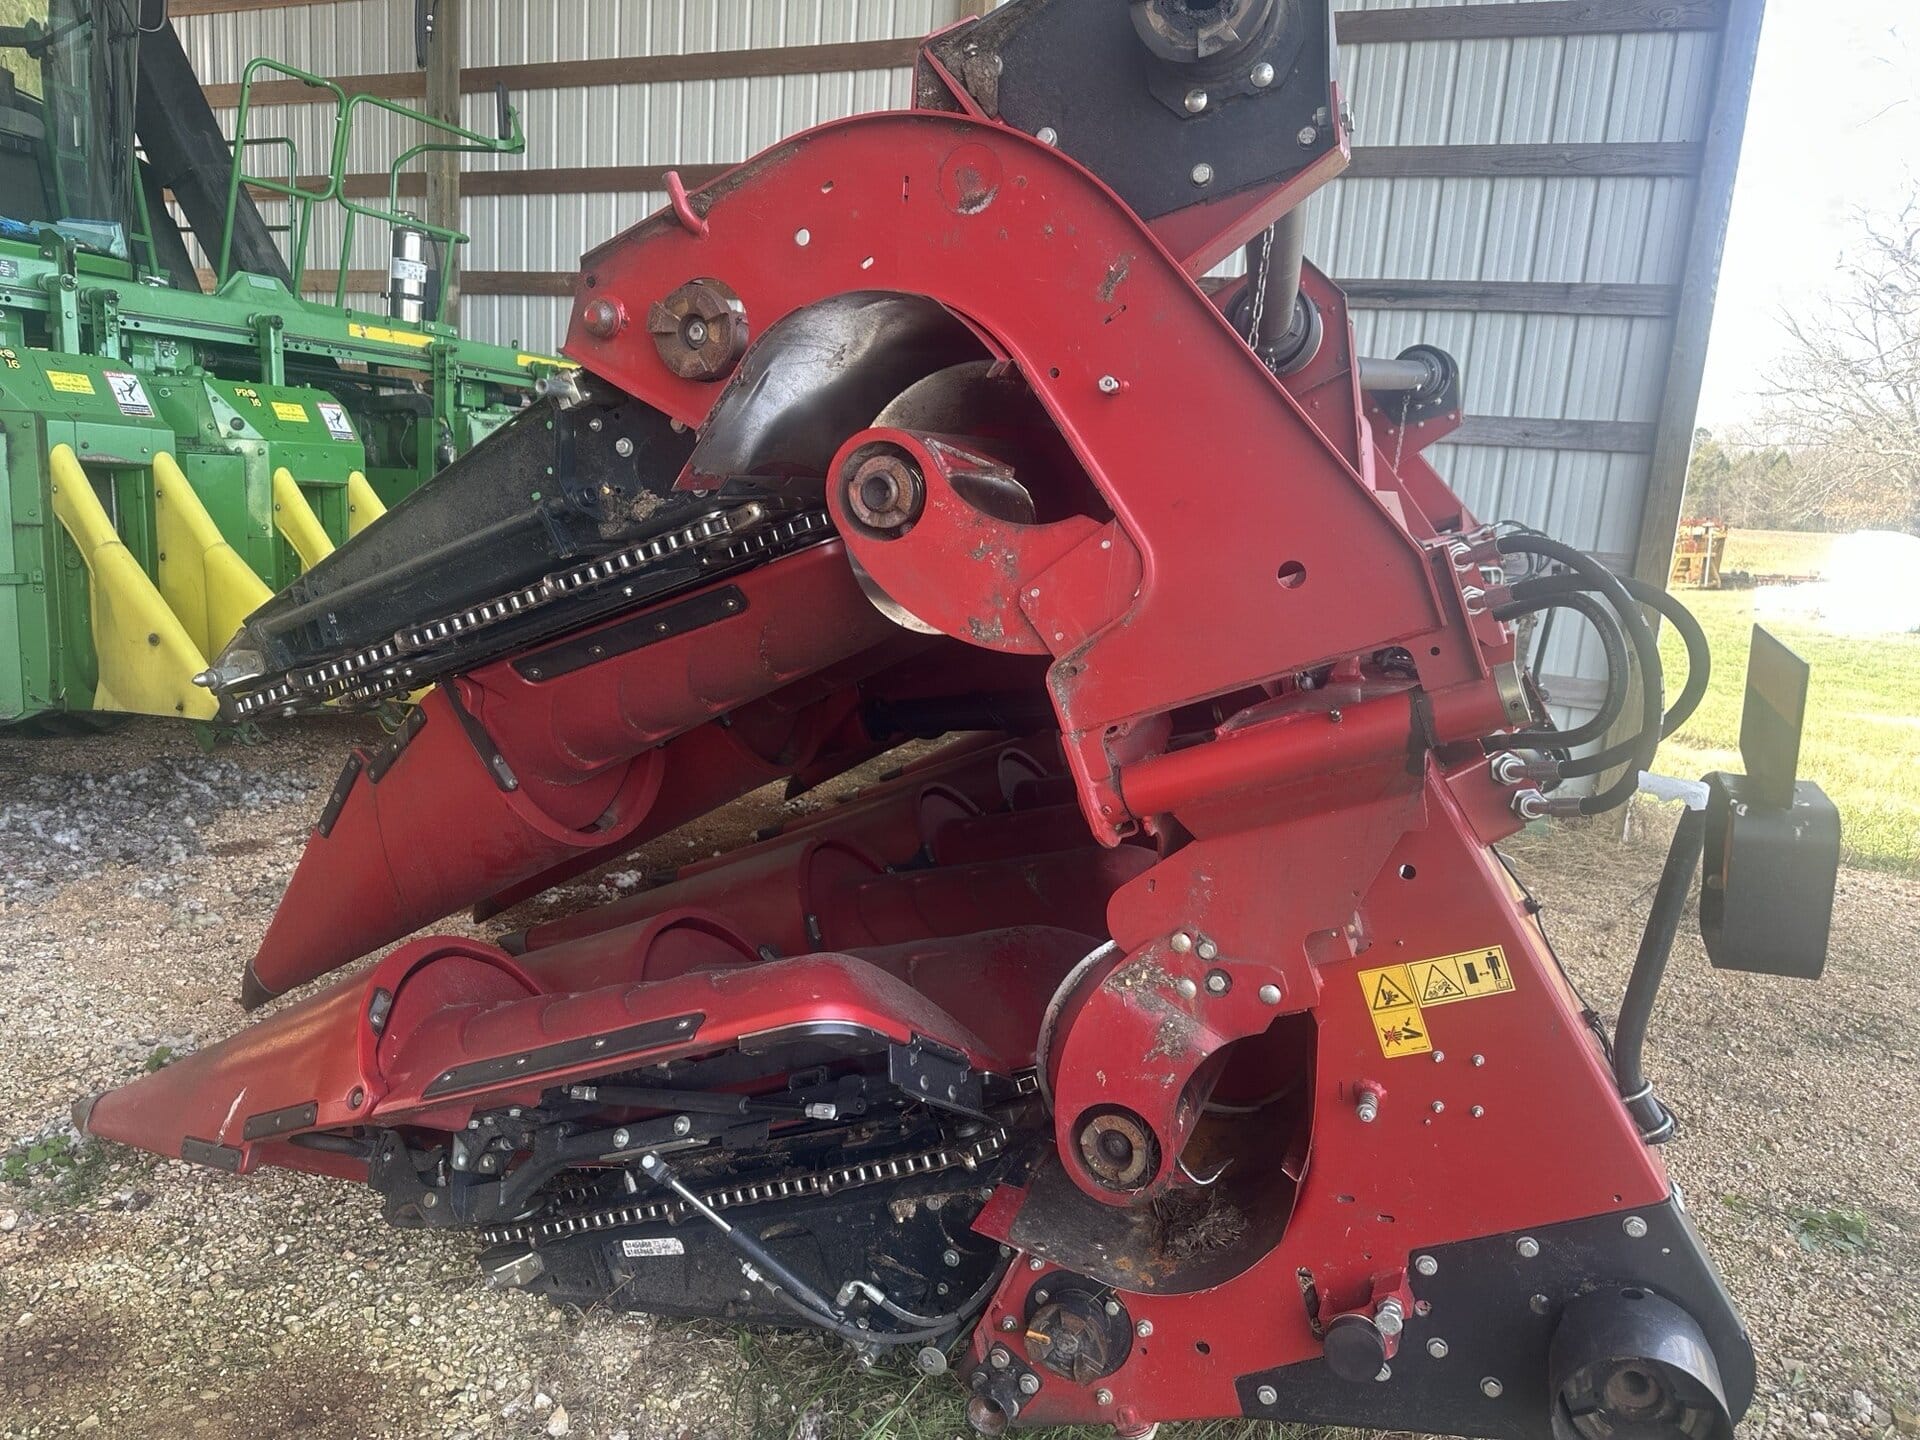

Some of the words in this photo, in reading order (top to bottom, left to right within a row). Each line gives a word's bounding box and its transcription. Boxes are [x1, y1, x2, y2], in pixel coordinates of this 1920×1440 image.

[5, 359, 21, 369] 16
[233, 387, 257, 398] PRO
[250, 397, 262, 407] 16
